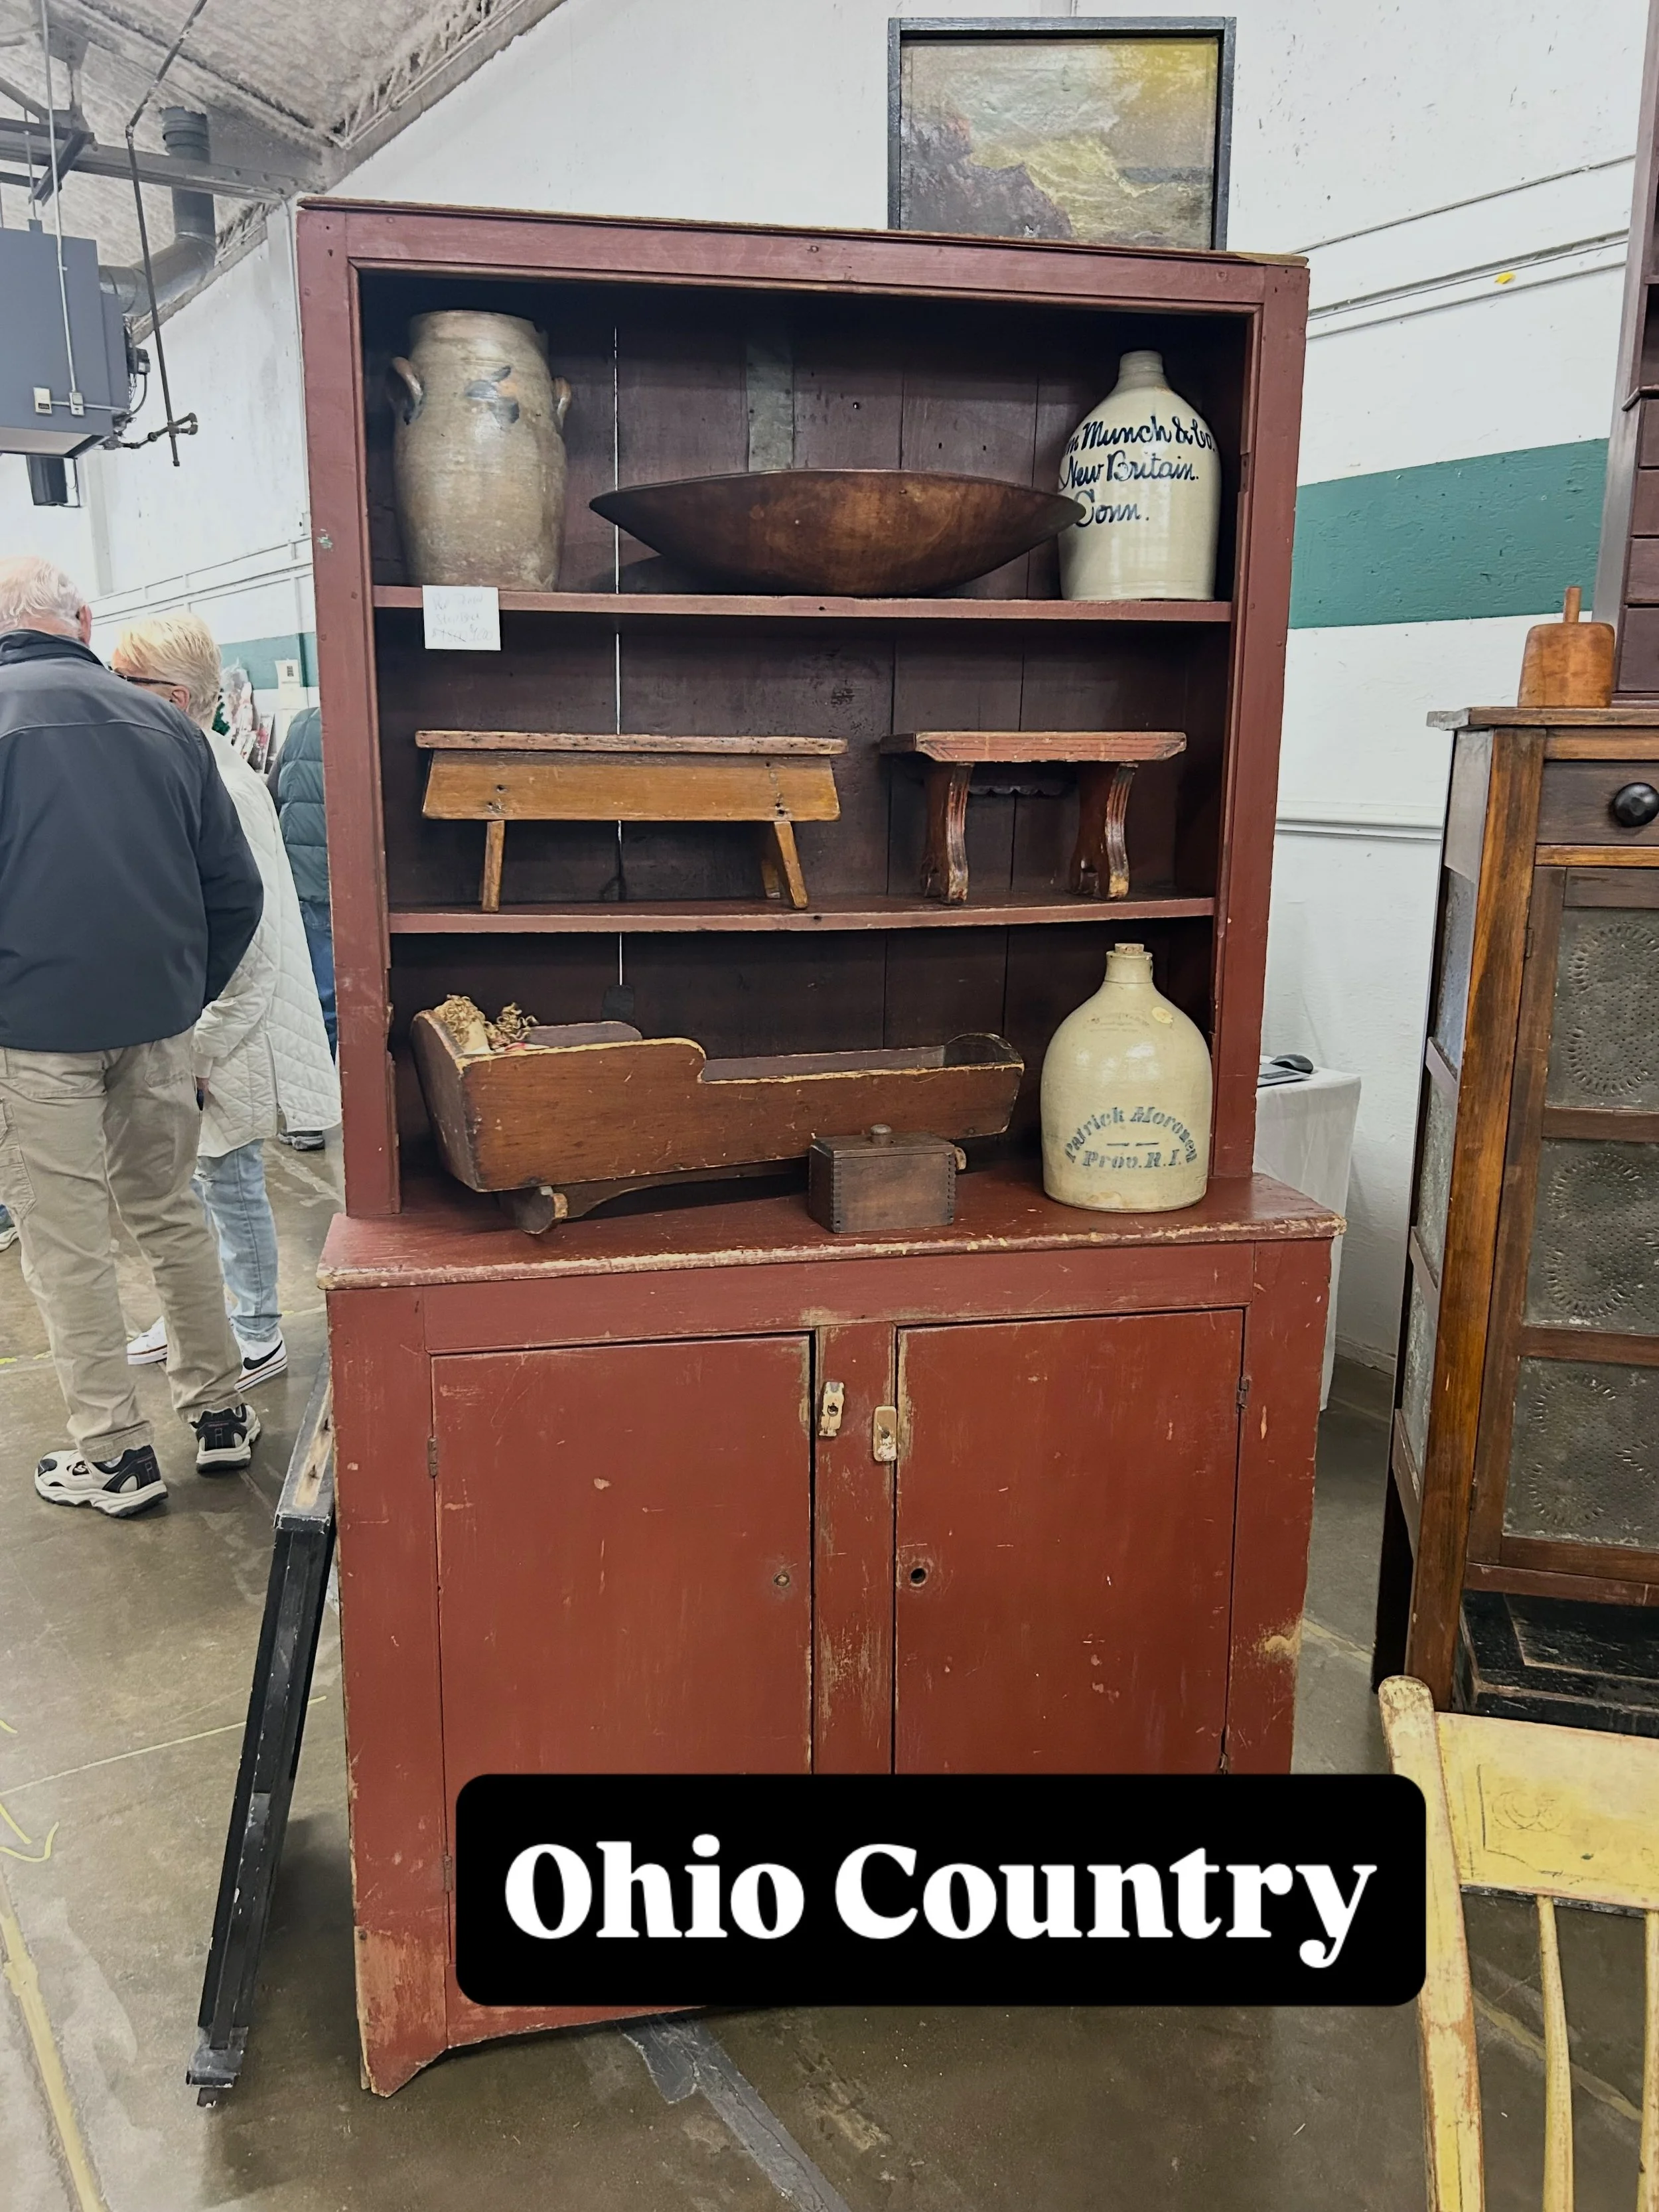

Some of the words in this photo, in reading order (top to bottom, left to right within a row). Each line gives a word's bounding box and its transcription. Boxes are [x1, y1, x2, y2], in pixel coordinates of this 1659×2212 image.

[1080, 415, 1172, 450] Munch
[1059, 455, 1104, 492] New
[1106, 449, 1199, 482] Britain.
[1074, 488, 1149, 528] Conn.
[1064, 1106, 1125, 1163] Patrick
